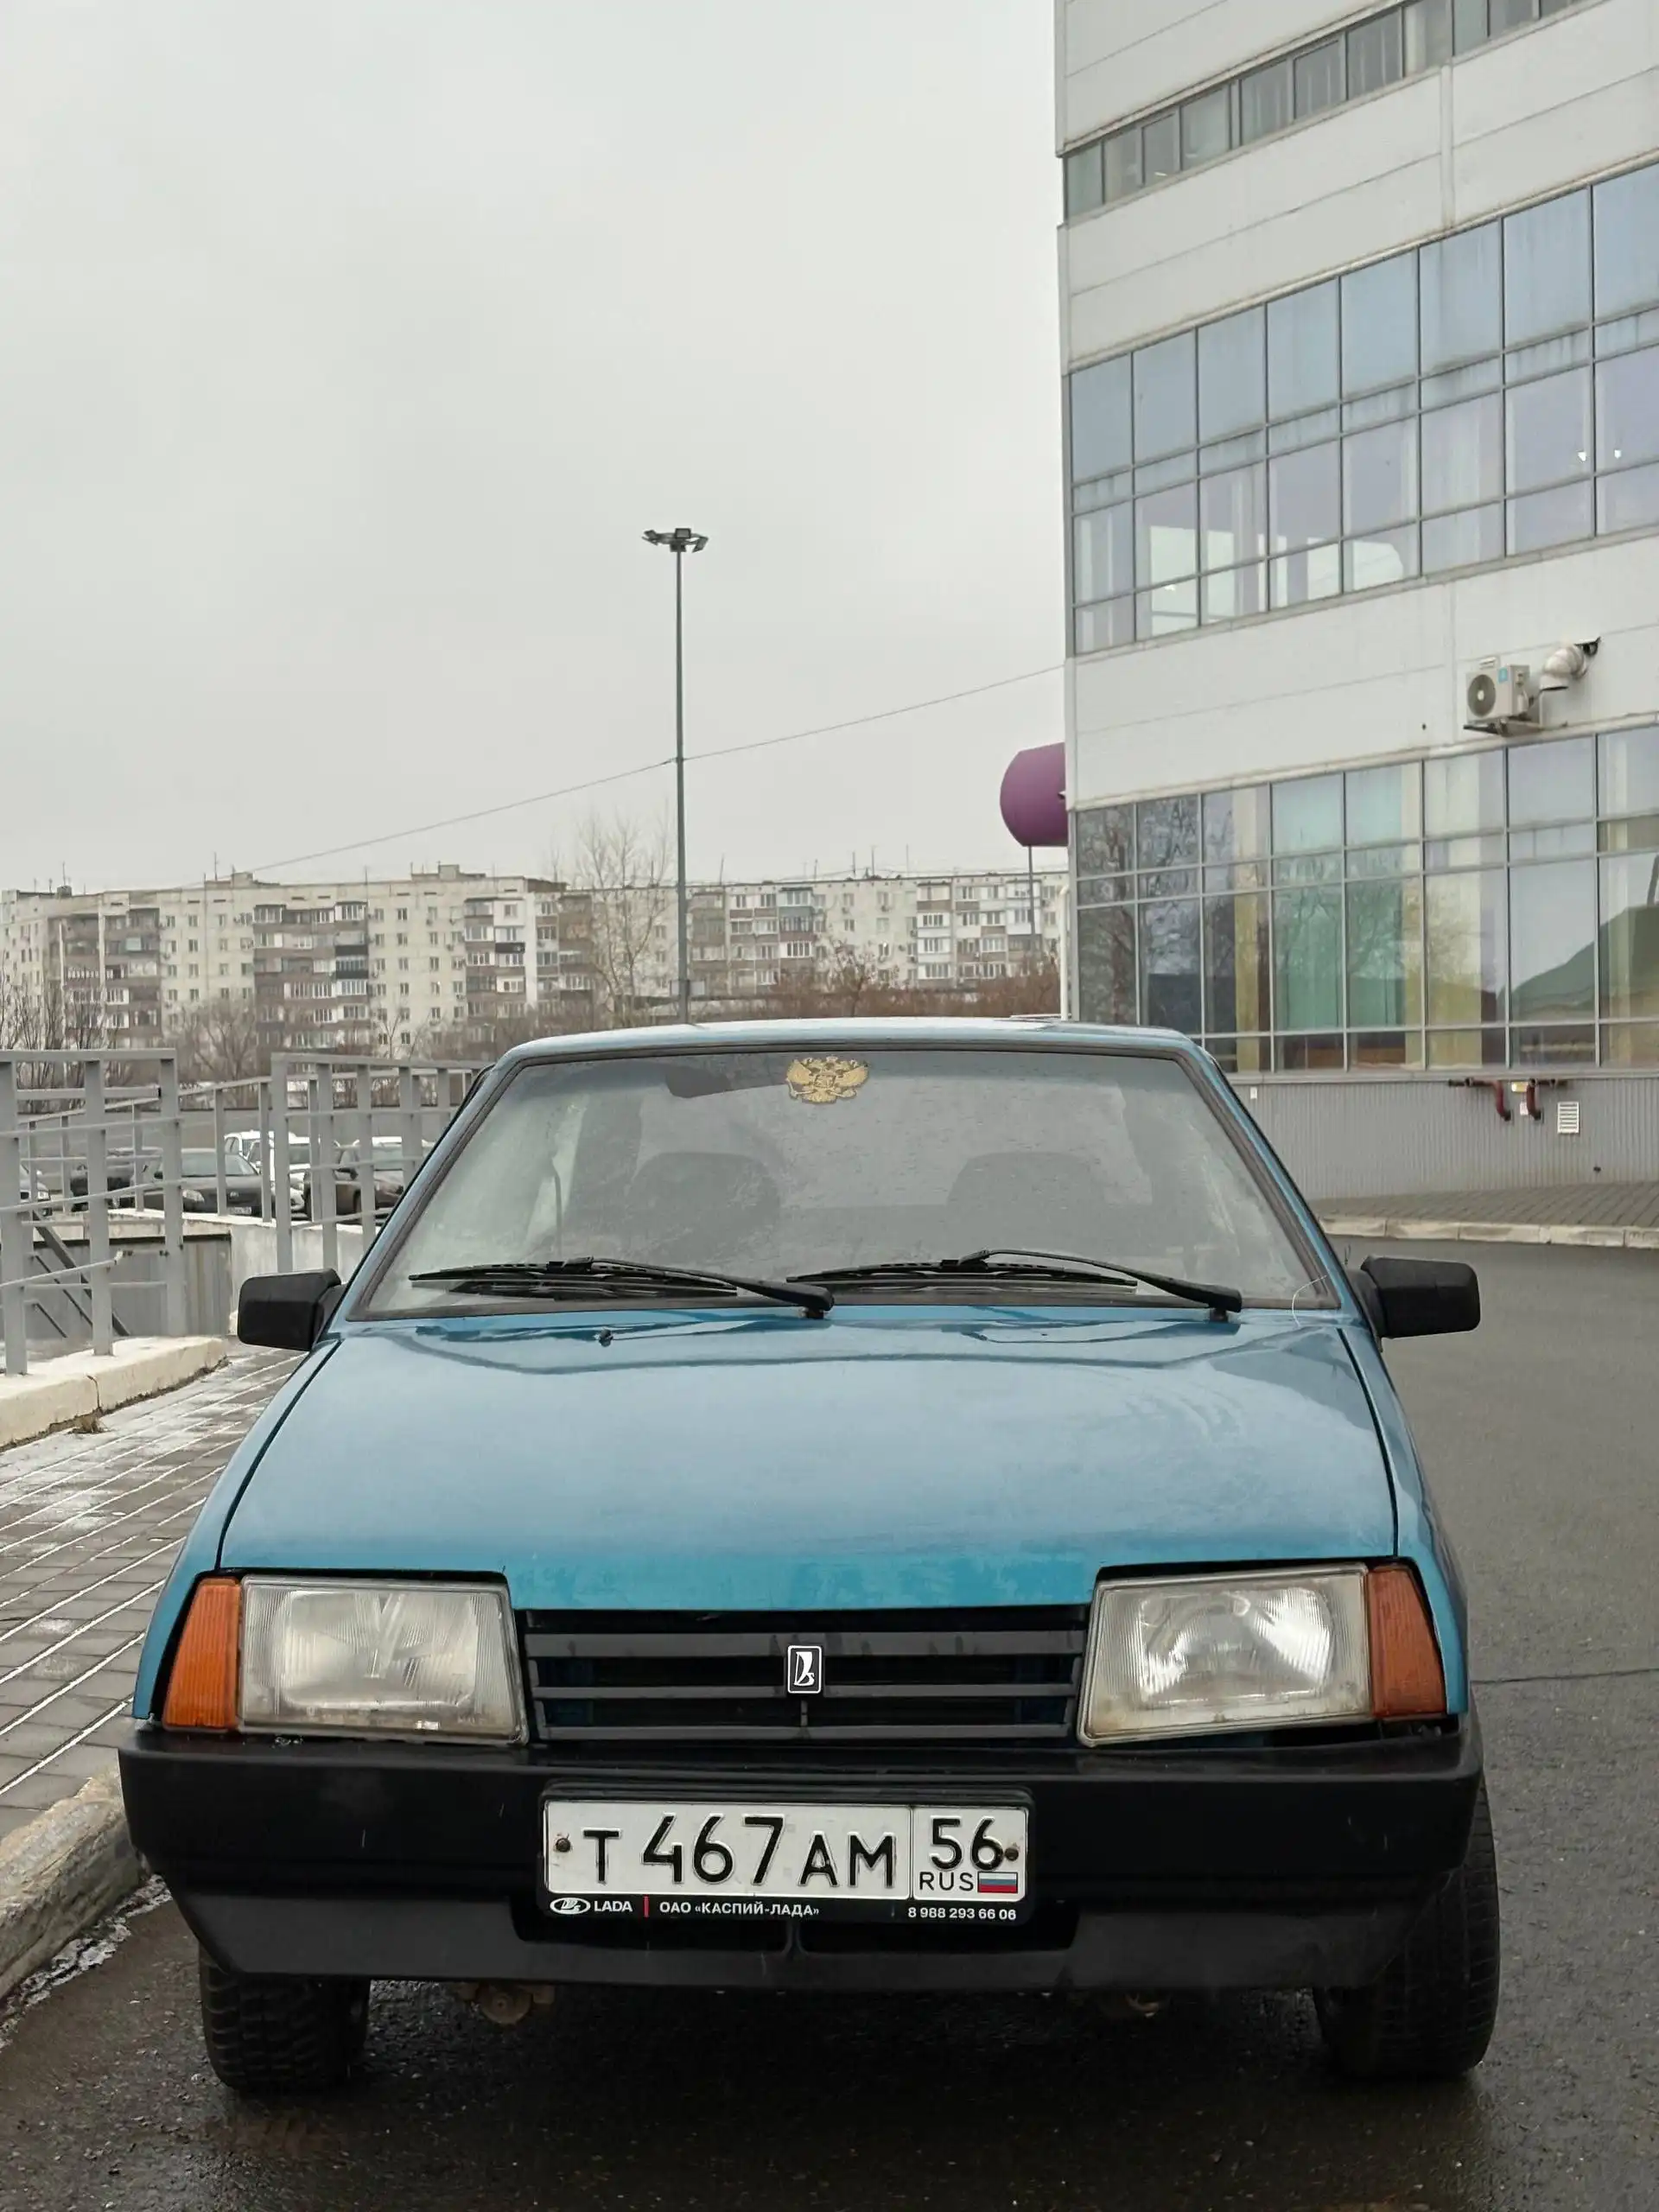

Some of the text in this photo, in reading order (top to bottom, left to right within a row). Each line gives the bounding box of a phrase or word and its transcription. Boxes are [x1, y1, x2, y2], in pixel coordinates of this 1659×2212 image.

[931, 1818, 1004, 1872] 56
[918, 1871, 974, 1891] RUS
[594, 1900, 633, 1912] LADA
[659, 1901, 691, 1913] ОАО
[907, 1906, 1017, 1921] 8 988 293 66 06
